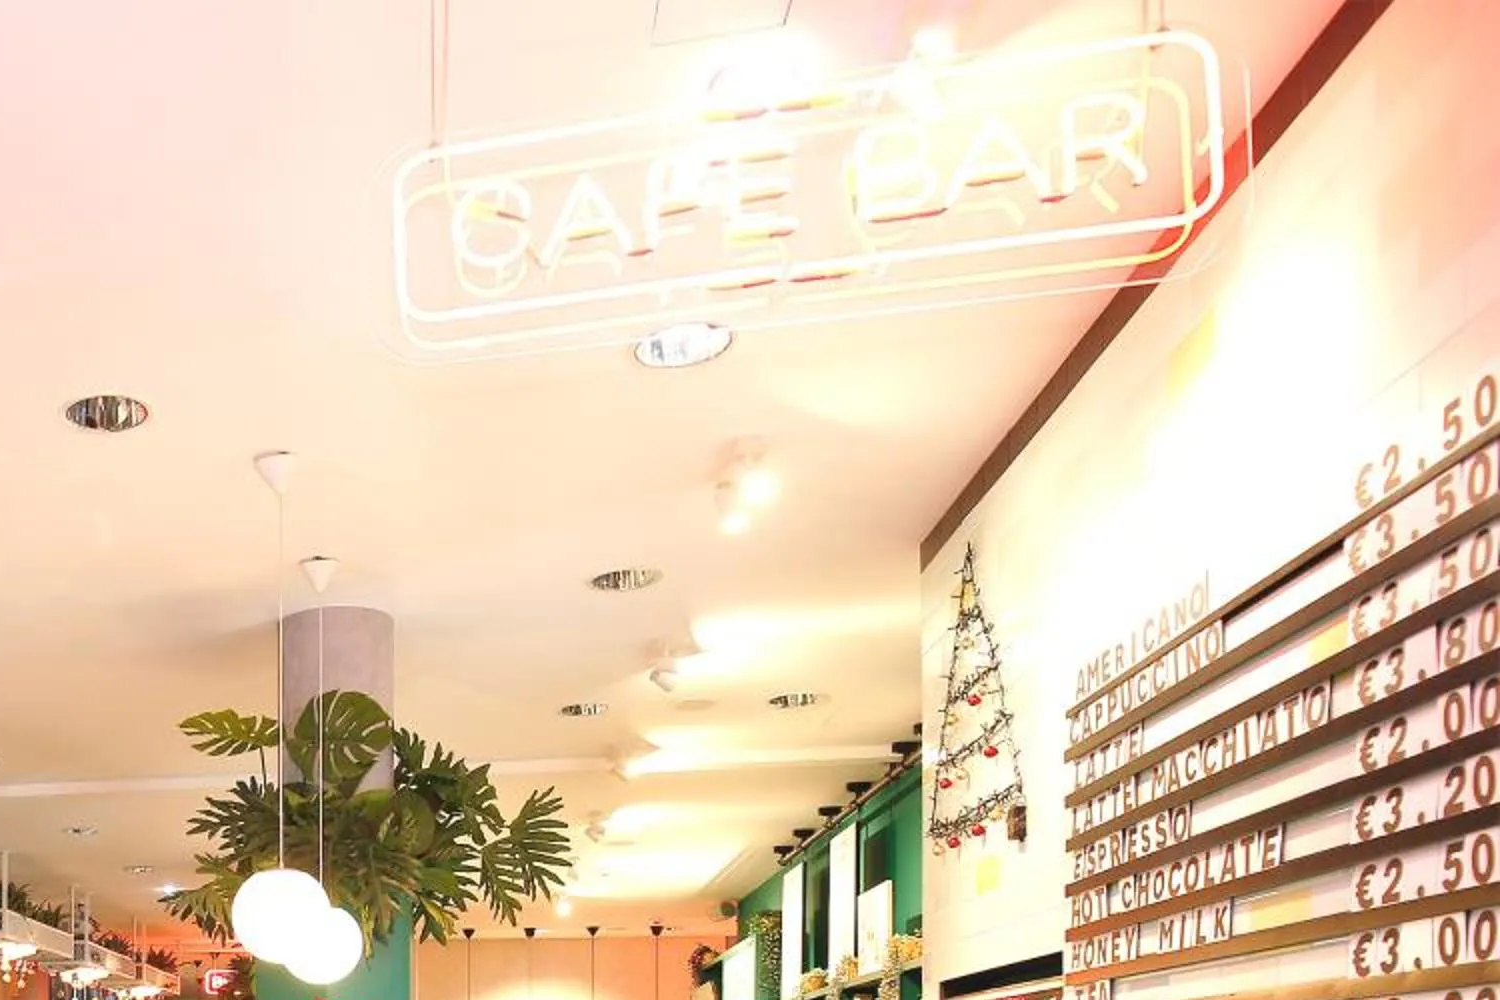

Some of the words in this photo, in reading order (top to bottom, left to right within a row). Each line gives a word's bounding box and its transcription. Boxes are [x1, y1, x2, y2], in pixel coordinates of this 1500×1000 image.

[852, 90, 1148, 224] BAR
[1069, 620, 1221, 745] CAPPUCCINO
[1348, 450, 1492, 576] €3.50
[1075, 582, 1205, 697] AMERICANO
[1355, 374, 1497, 510] €2.50
[1072, 780, 1137, 835] LATTE
[1151, 685, 1327, 800] MACCHIATO
[1357, 600, 1499, 707] €3.80
[1073, 724, 1141, 790] LATTE
[1351, 527, 1493, 641] €3.50
[1071, 886, 1106, 928] HOT
[1121, 828, 1280, 909] CHOCOLATE
[1355, 755, 1496, 842] €3.20
[1073, 805, 1189, 880] ESPRESSO
[1359, 676, 1500, 774] €2.00
[1071, 925, 1137, 969] HONEY
[1158, 905, 1229, 951] MILK
[1355, 833, 1496, 909] €2.50
[1352, 909, 1498, 977] €3.00
